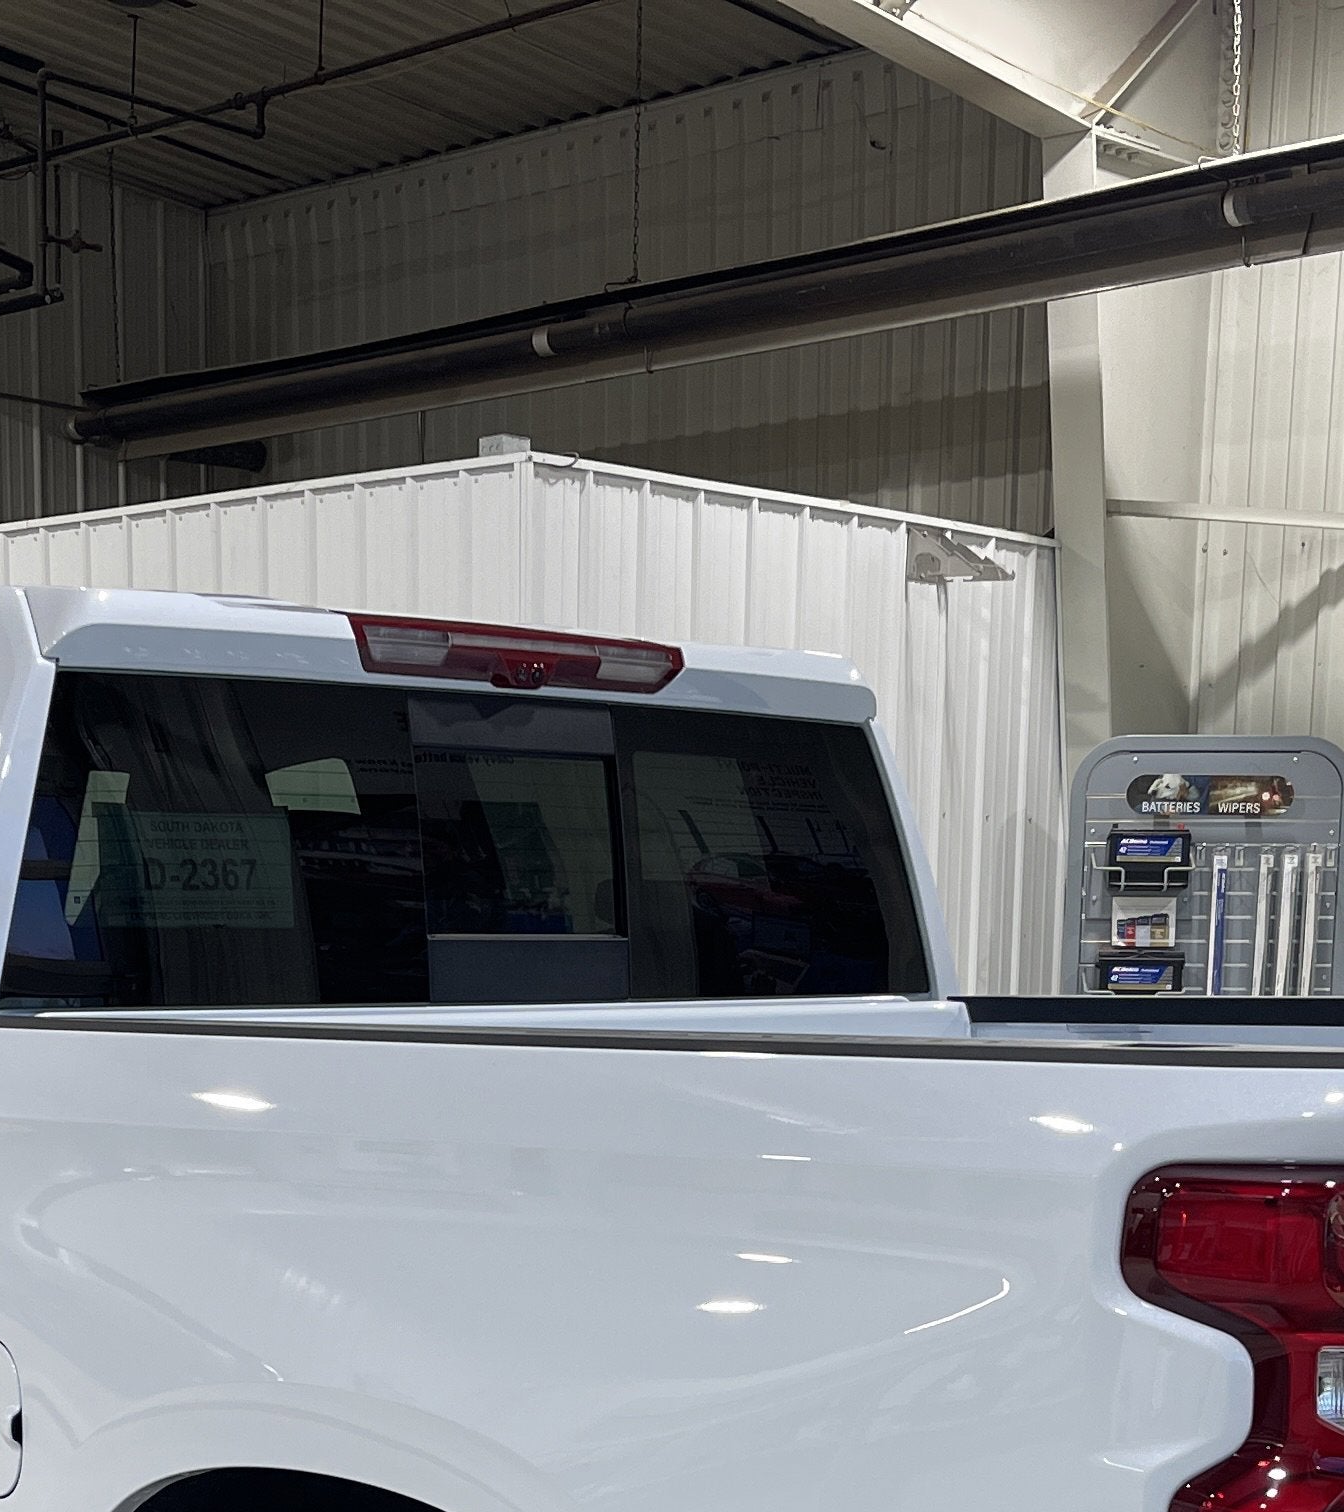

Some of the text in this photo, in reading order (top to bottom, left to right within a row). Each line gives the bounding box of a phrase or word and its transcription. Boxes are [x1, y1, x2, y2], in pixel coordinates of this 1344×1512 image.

[1141, 801, 1262, 814] BATTERIES WIPERS
[150, 820, 245, 833] SOUTH DAKOTA
[202, 838, 250, 850] DEALER
[142, 856, 257, 891] D-2367
